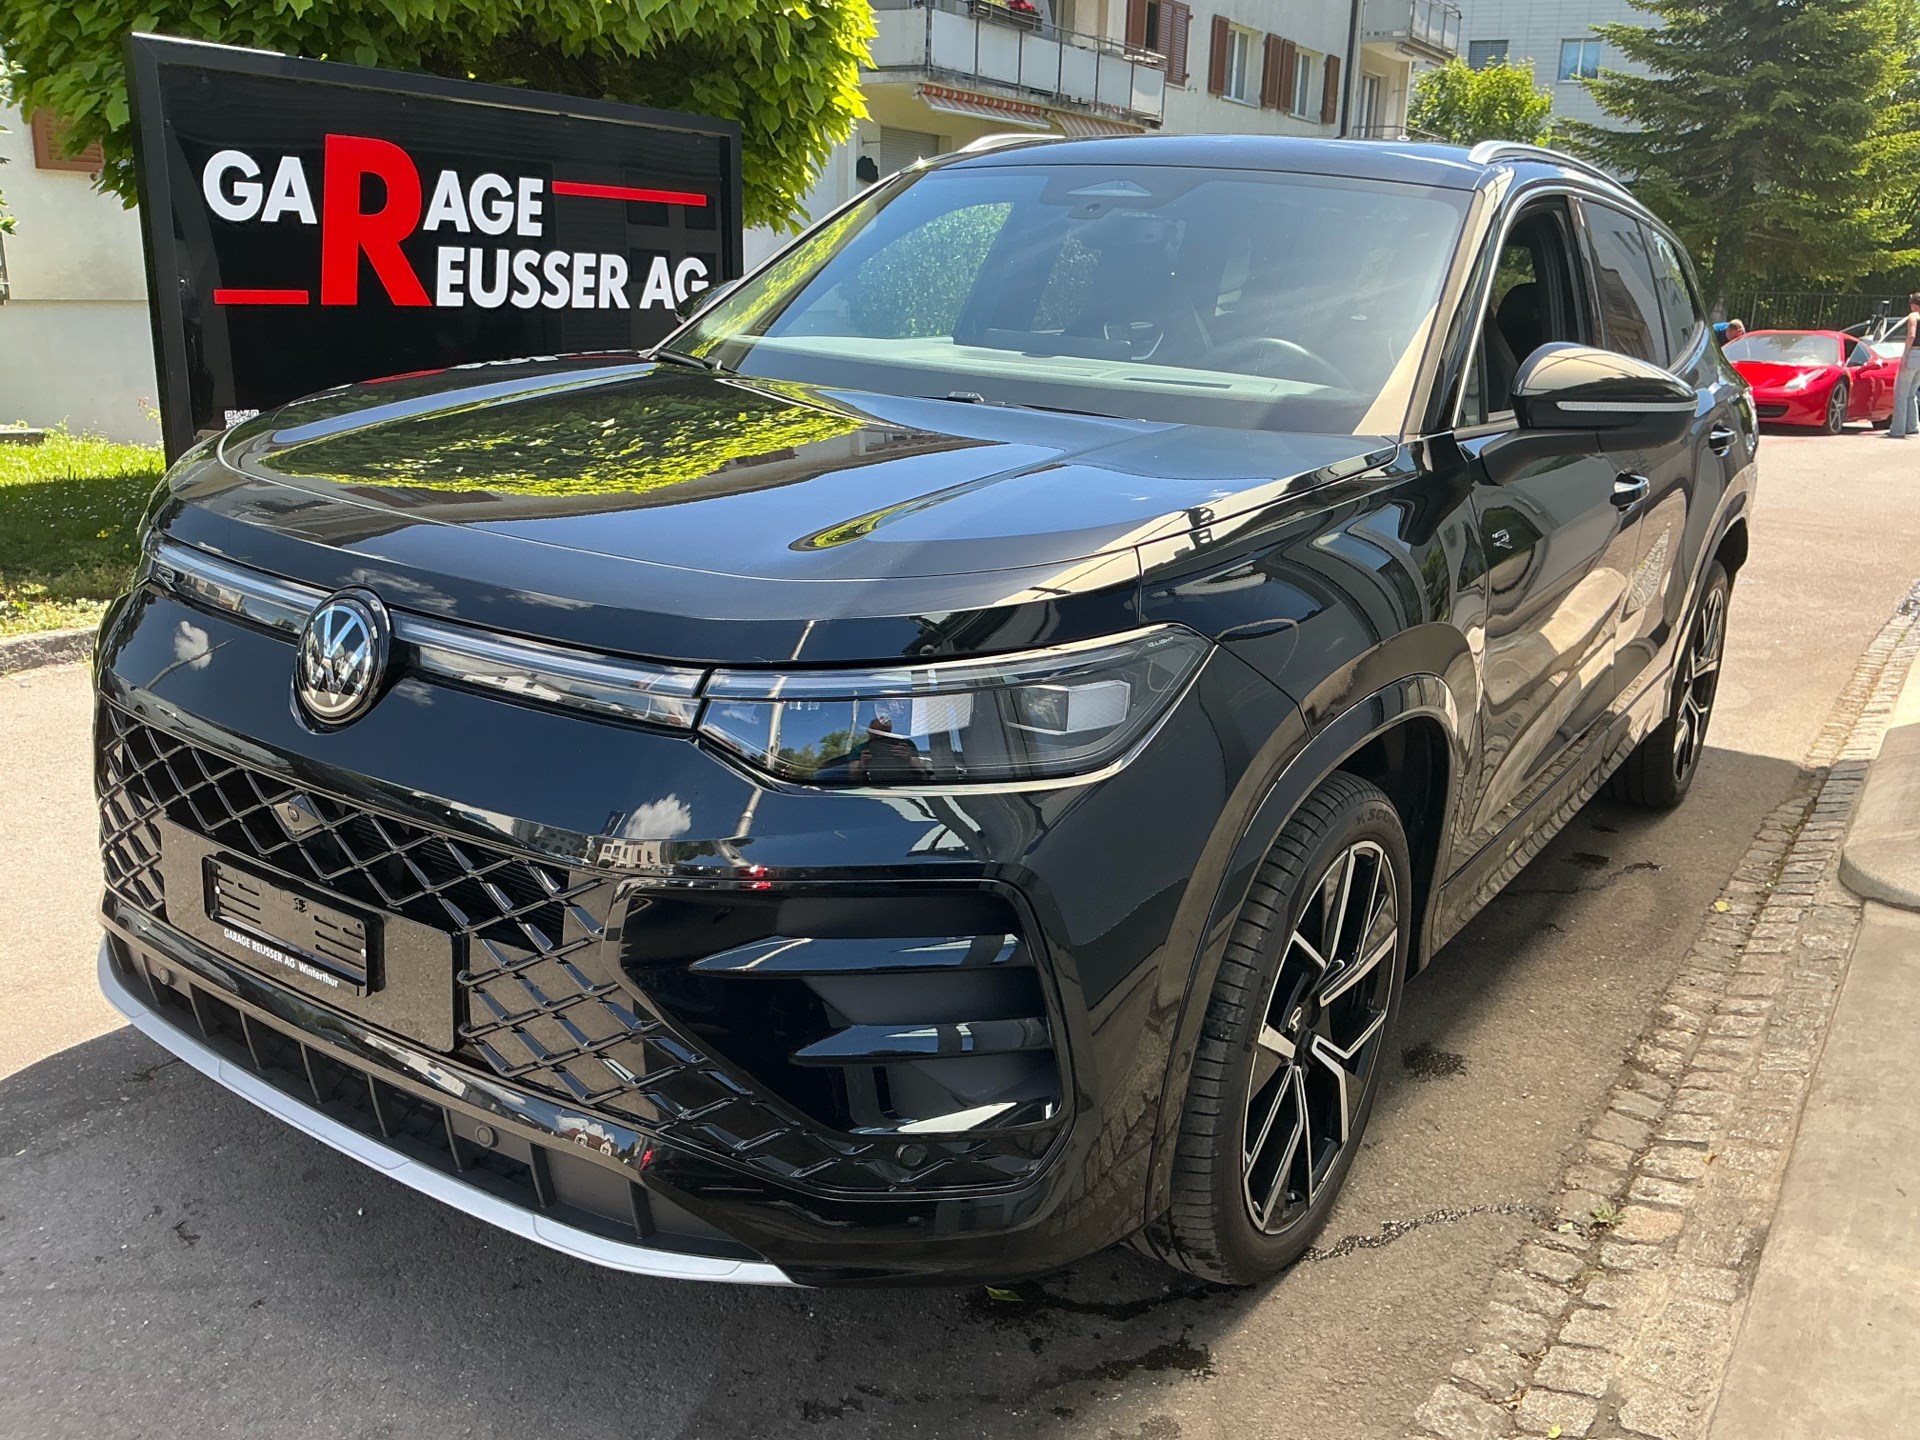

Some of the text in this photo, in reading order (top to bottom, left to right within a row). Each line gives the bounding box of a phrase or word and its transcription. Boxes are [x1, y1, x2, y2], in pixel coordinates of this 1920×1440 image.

[203, 134, 543, 306] GARAGE
[639, 256, 709, 309] AG
[223, 928, 339, 988] GARAGE REUSSER AG Winterthur
